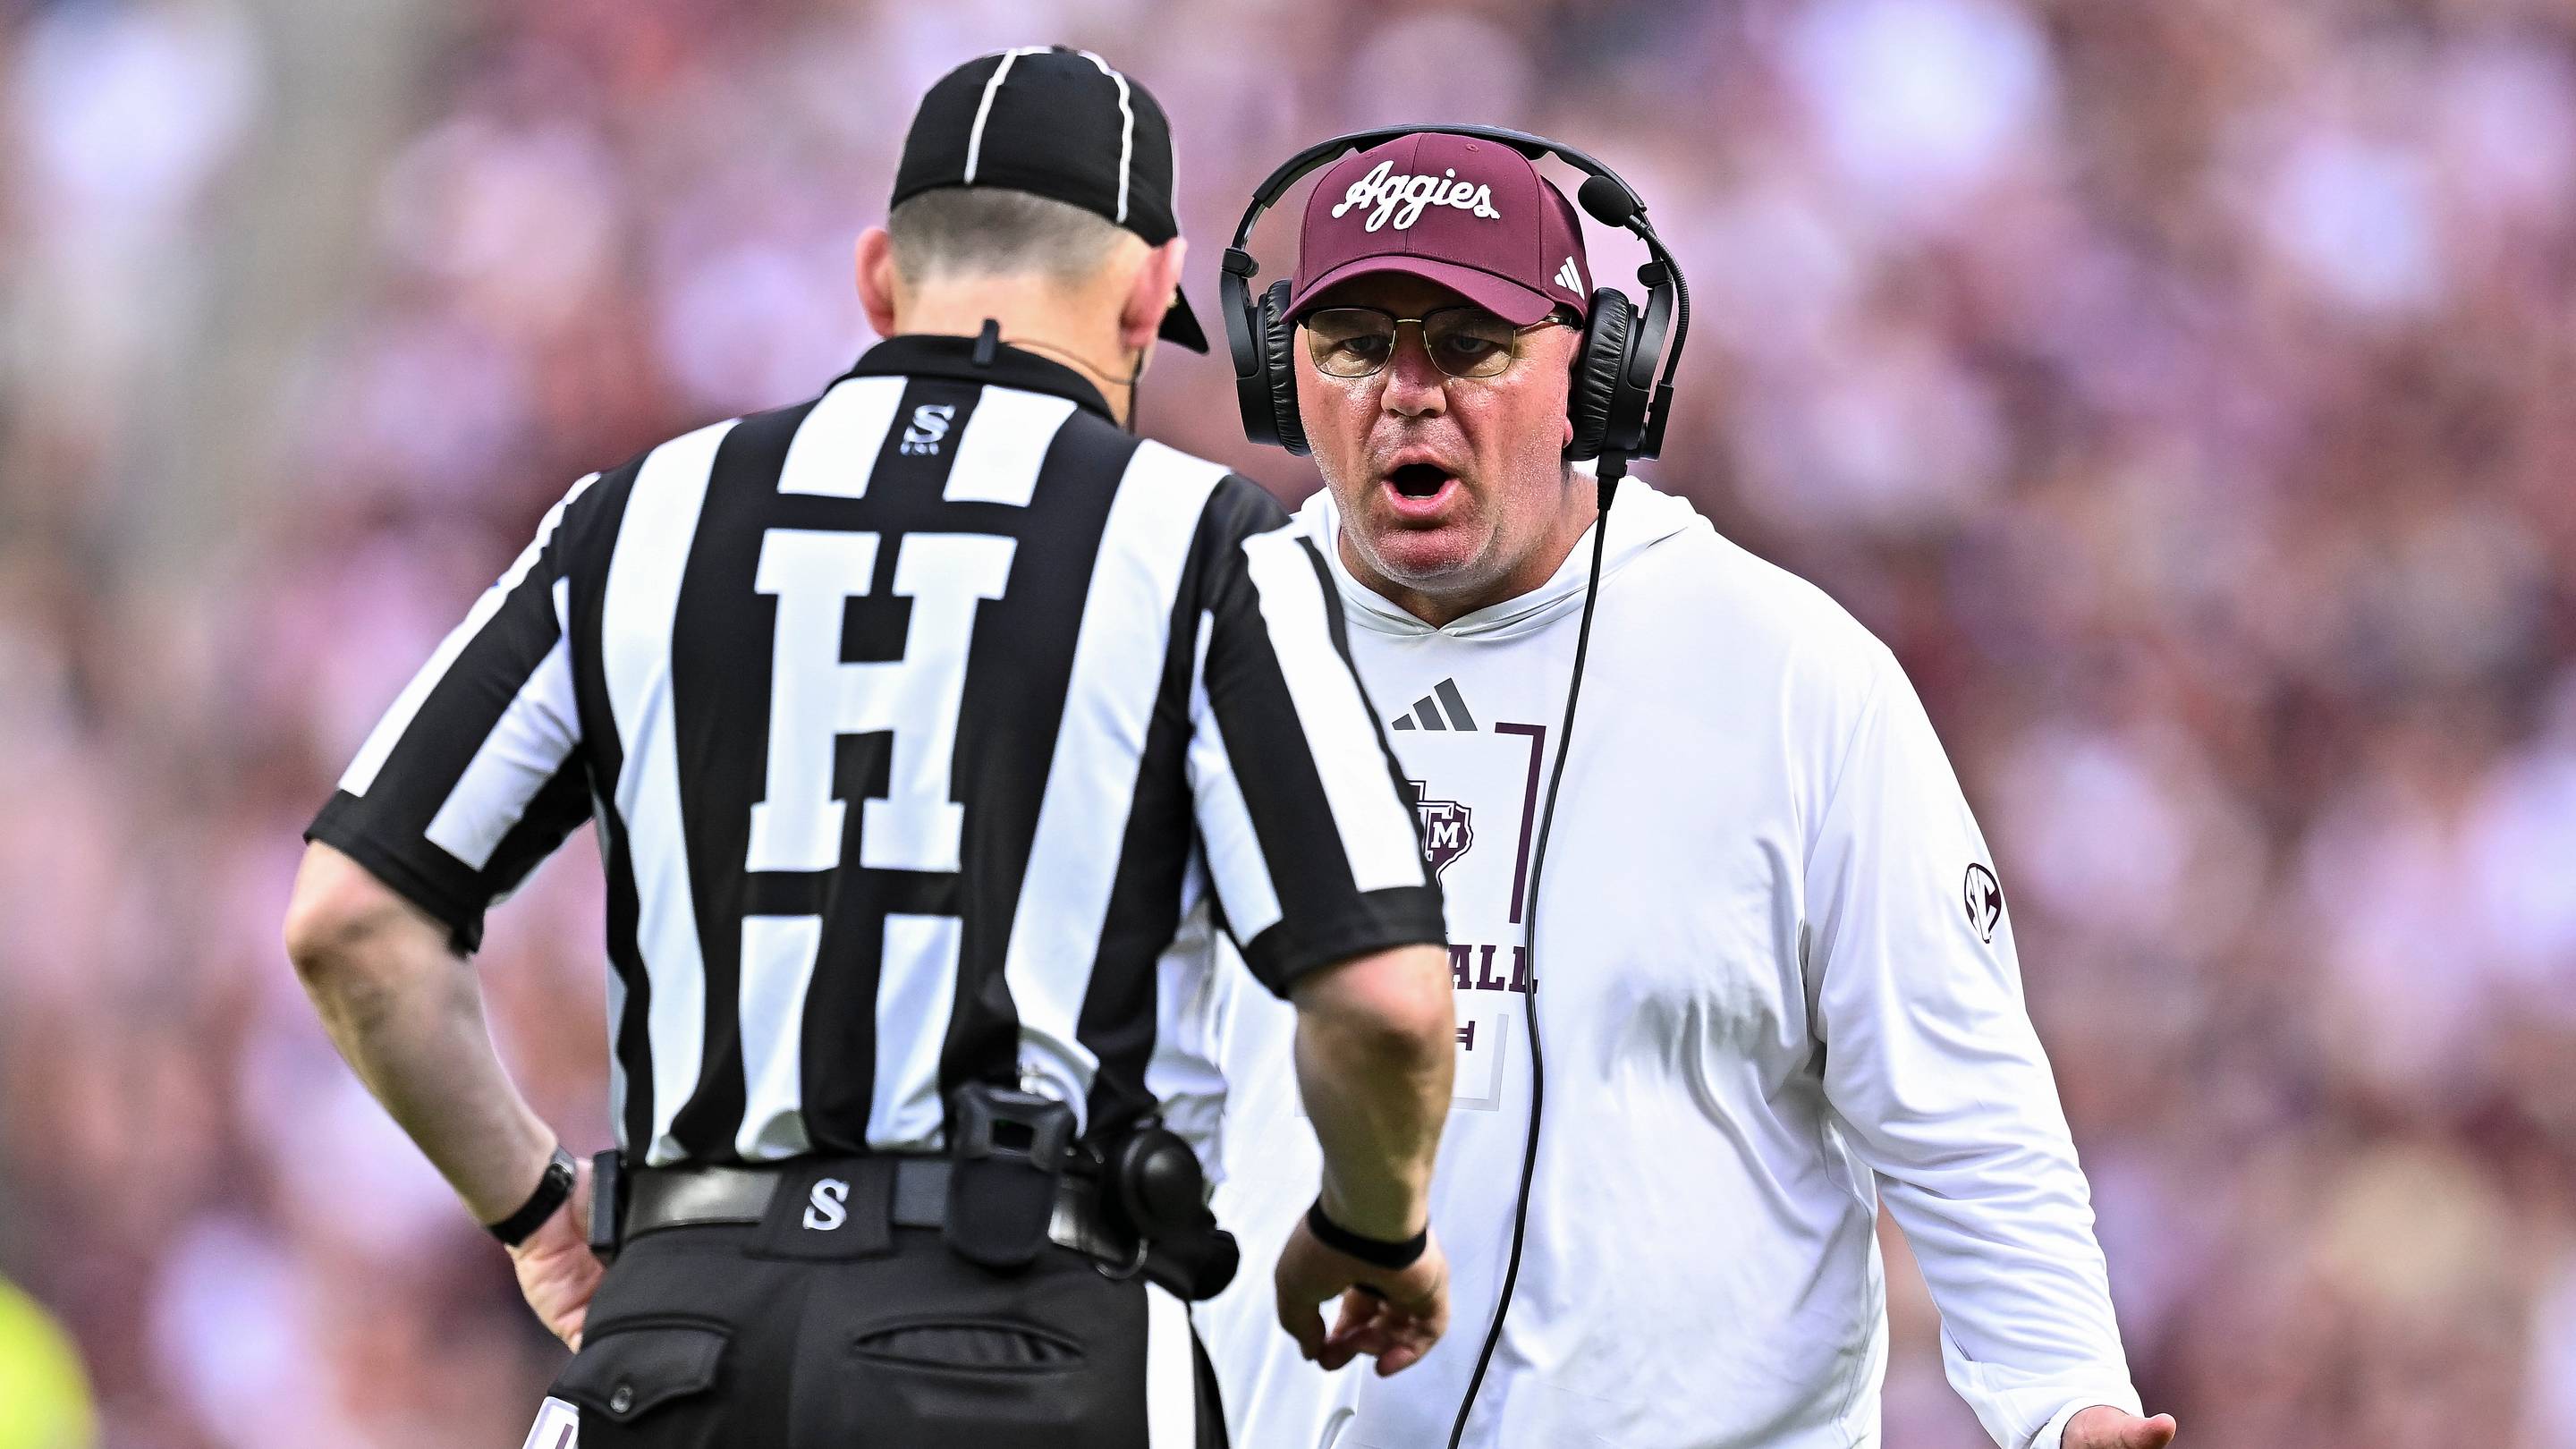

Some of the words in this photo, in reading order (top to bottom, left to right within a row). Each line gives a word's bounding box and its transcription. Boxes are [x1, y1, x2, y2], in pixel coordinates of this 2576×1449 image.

[1331, 160, 1501, 233] Aggies
[745, 528, 1018, 873] H
[802, 1177, 850, 1230] S
